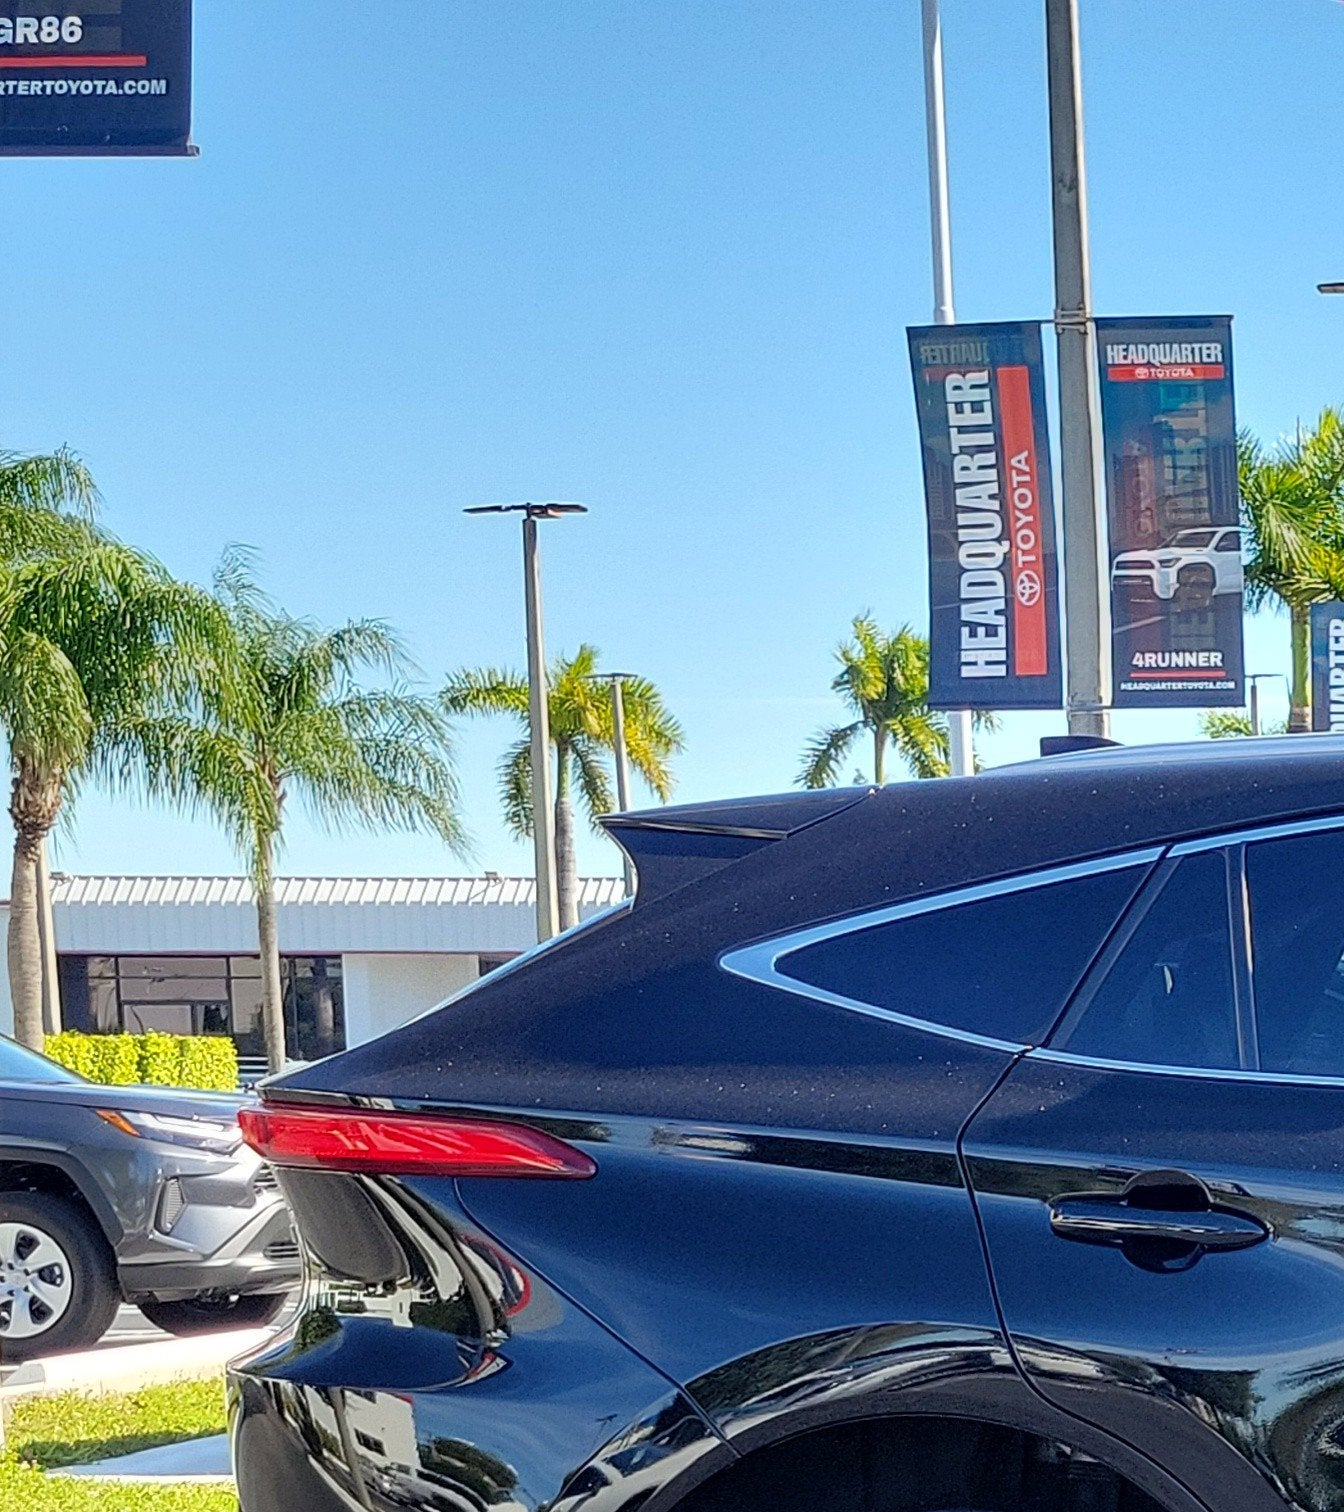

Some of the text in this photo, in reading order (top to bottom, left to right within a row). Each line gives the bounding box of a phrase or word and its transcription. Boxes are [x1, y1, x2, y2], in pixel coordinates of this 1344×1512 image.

[0, 16, 83, 44] GR86
[1106, 343, 1223, 365] HEADQUARTER
[1149, 367, 1194, 378] TOYOTA
[1008, 450, 1038, 569] TOYOTA
[944, 370, 1010, 677] HEADQUARTER
[1131, 652, 1223, 667] 4RUNNER
